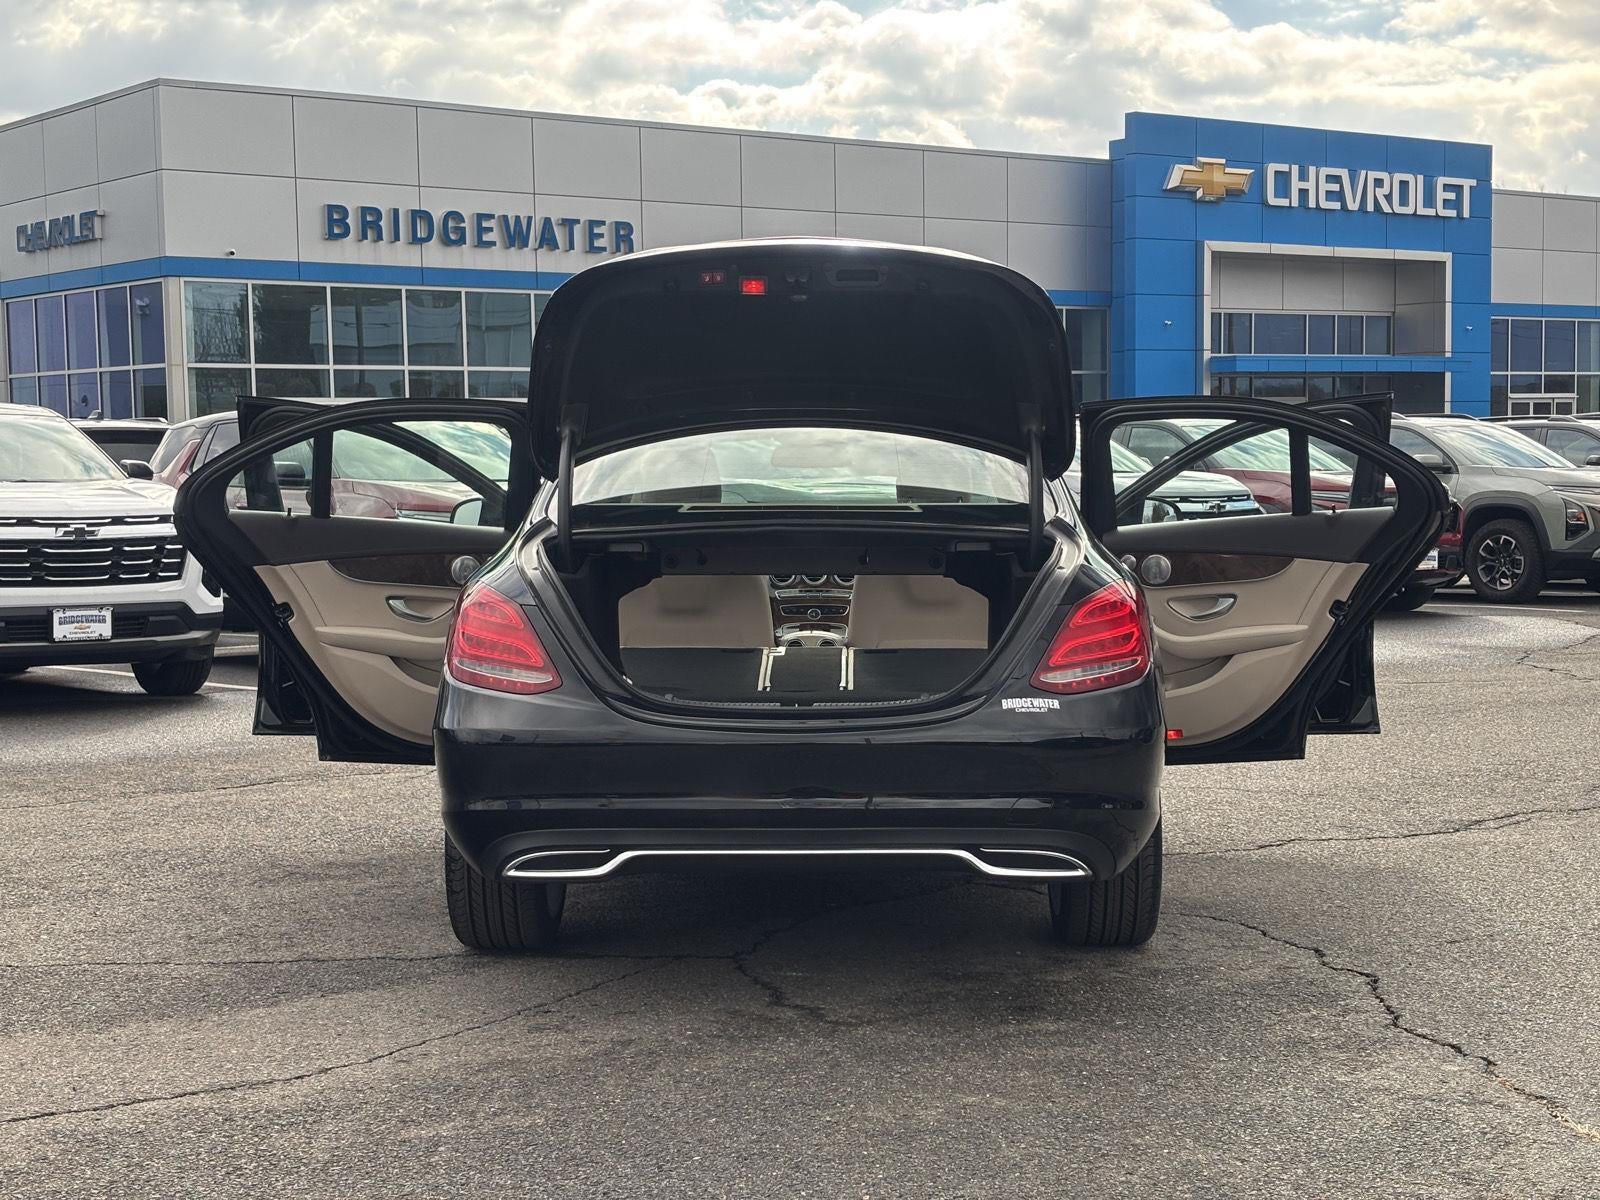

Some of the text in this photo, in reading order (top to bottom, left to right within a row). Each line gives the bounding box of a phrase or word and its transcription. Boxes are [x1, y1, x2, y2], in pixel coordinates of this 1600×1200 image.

[1265, 162, 1477, 219] CHEVROLET
[16, 209, 105, 252] CHEVROLET
[324, 203, 635, 253] BRIDGEWATER
[58, 614, 107, 626] BRIDGEWATER
[1001, 697, 1061, 710] BRIDGEWATER
